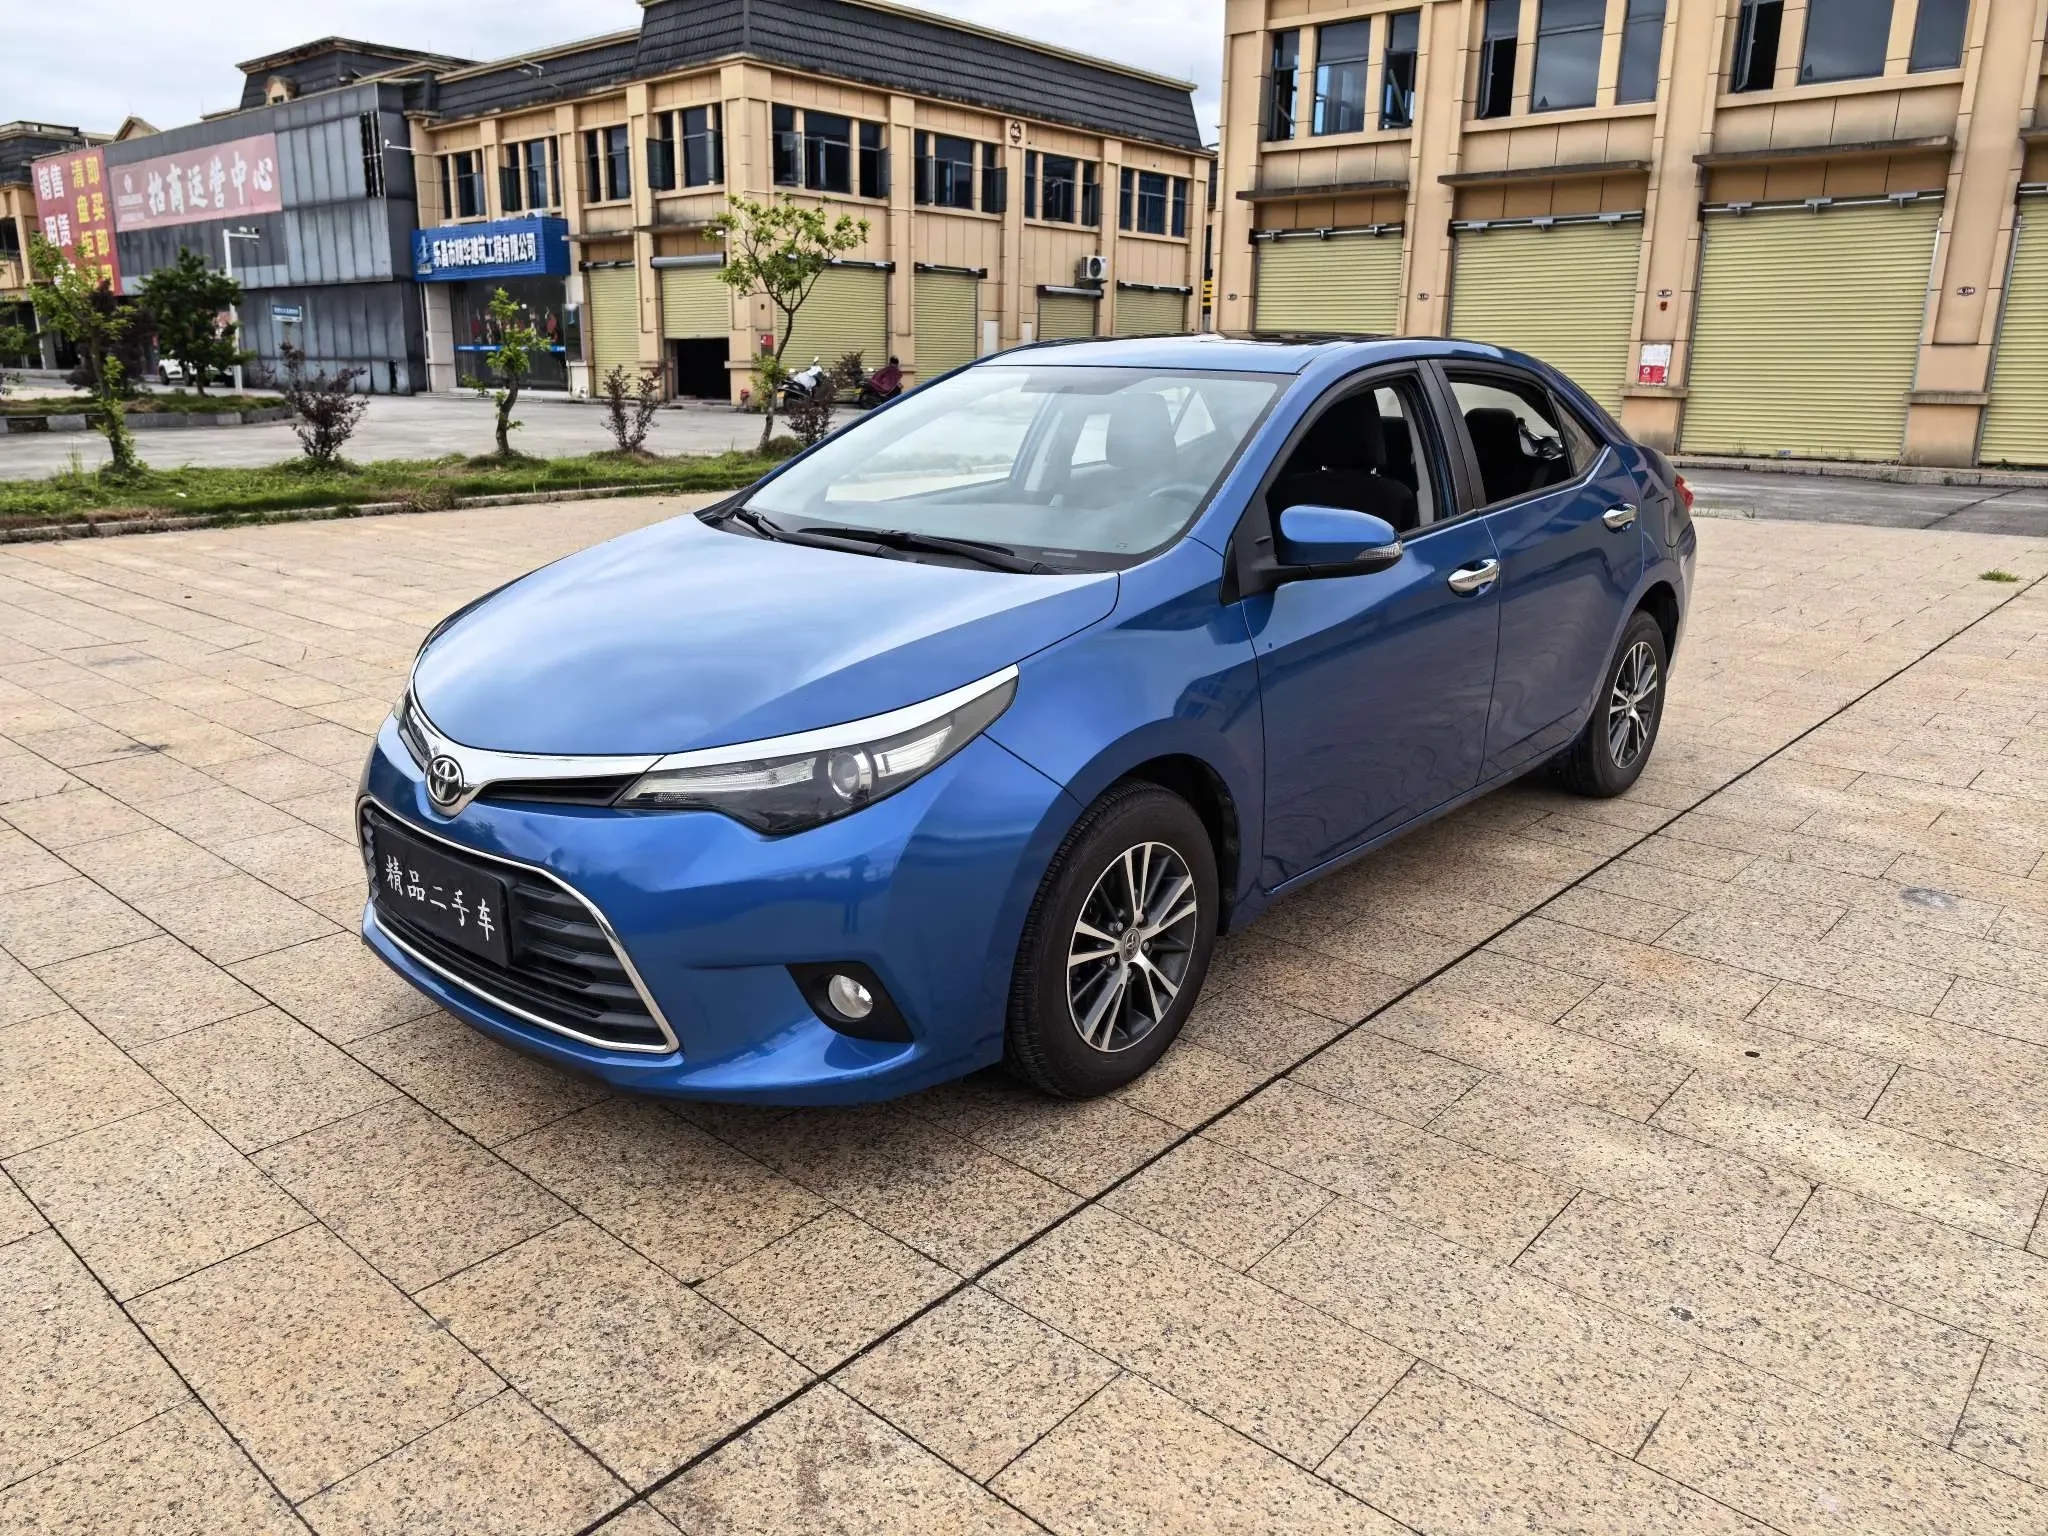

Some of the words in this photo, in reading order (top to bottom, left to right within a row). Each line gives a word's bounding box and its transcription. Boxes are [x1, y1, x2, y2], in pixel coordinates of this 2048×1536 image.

[386, 855, 495, 941] 精品二手车
